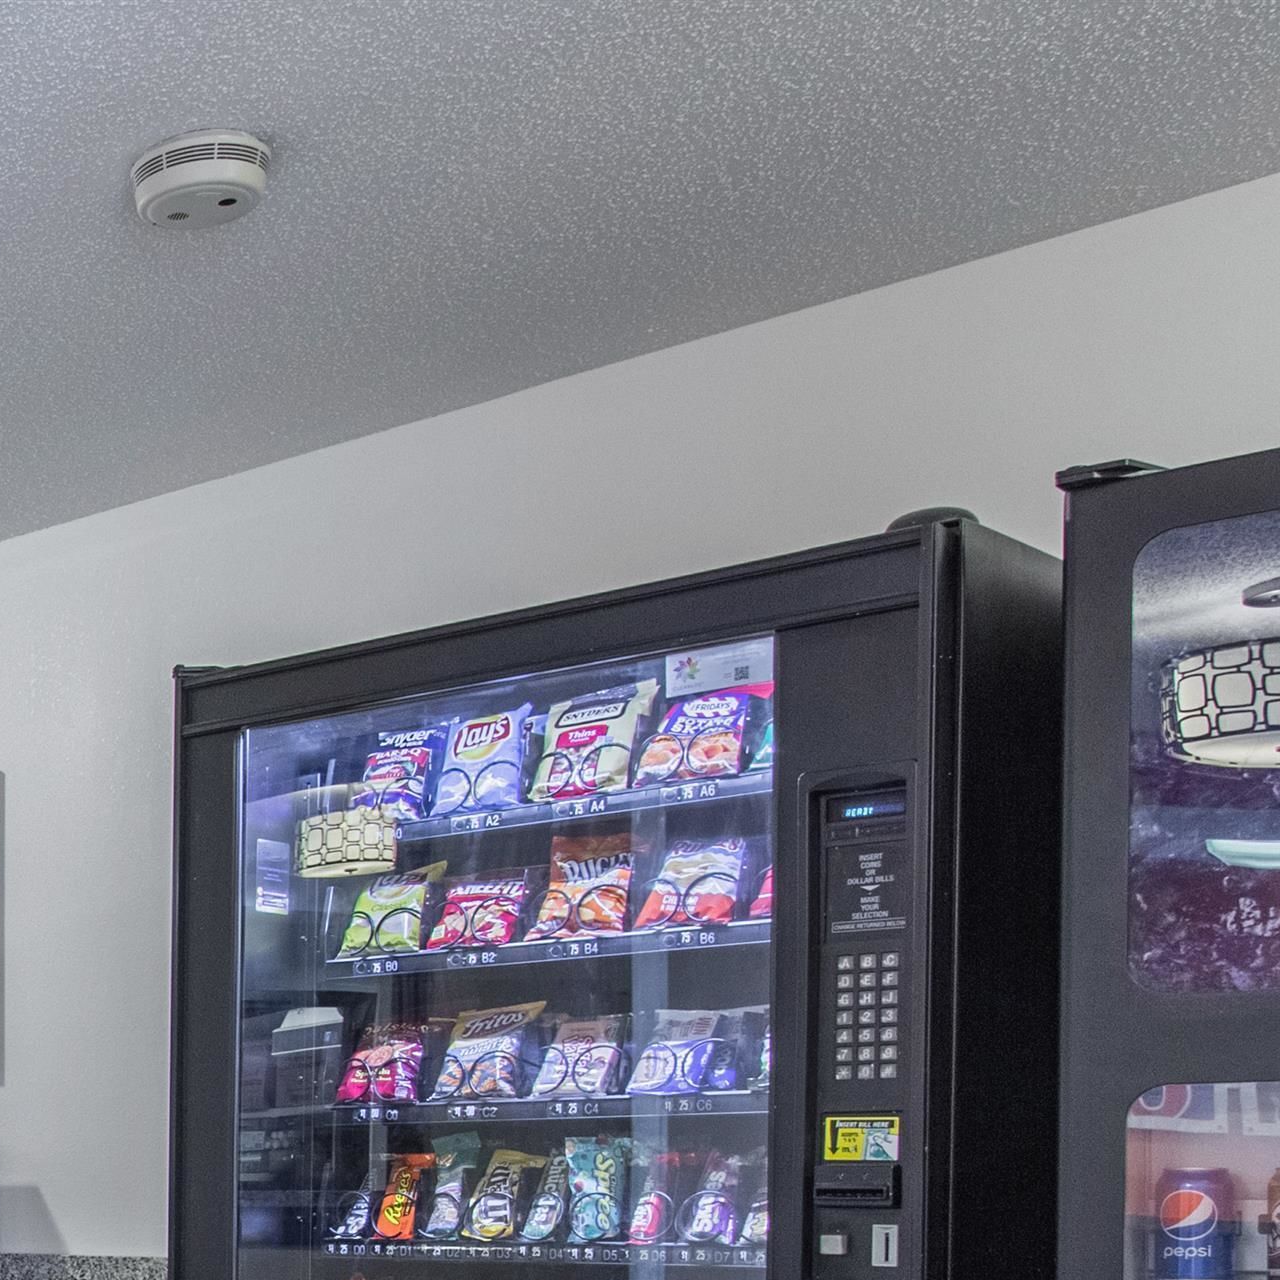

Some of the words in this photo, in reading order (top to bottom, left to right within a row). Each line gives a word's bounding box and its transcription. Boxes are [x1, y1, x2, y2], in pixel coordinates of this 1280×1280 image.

[700, 784, 715, 796] A6
[591, 800, 605, 812] A4
[486, 815, 500, 827] A2
[859, 853, 883, 861] INSERT
[847, 876, 874, 885] DOLLAR
[861, 903, 879, 911] YOUR
[852, 911, 888, 920] SELECTION
[700, 932, 715, 944] B6
[584, 943, 598, 954] B4
[482, 953, 496, 963] B2
[462, 1012, 524, 1038] Fritos
[584, 1103, 599, 1114] C4
[696, 1100, 712, 1110] C6
[535, 1154, 566, 1222] Chucles
[549, 1248, 563, 1259] D4
[603, 1249, 618, 1260] D5
[651, 1249, 666, 1261] D6
[714, 1251, 730, 1263] D7
[1163, 1245, 1212, 1259] pepsi
